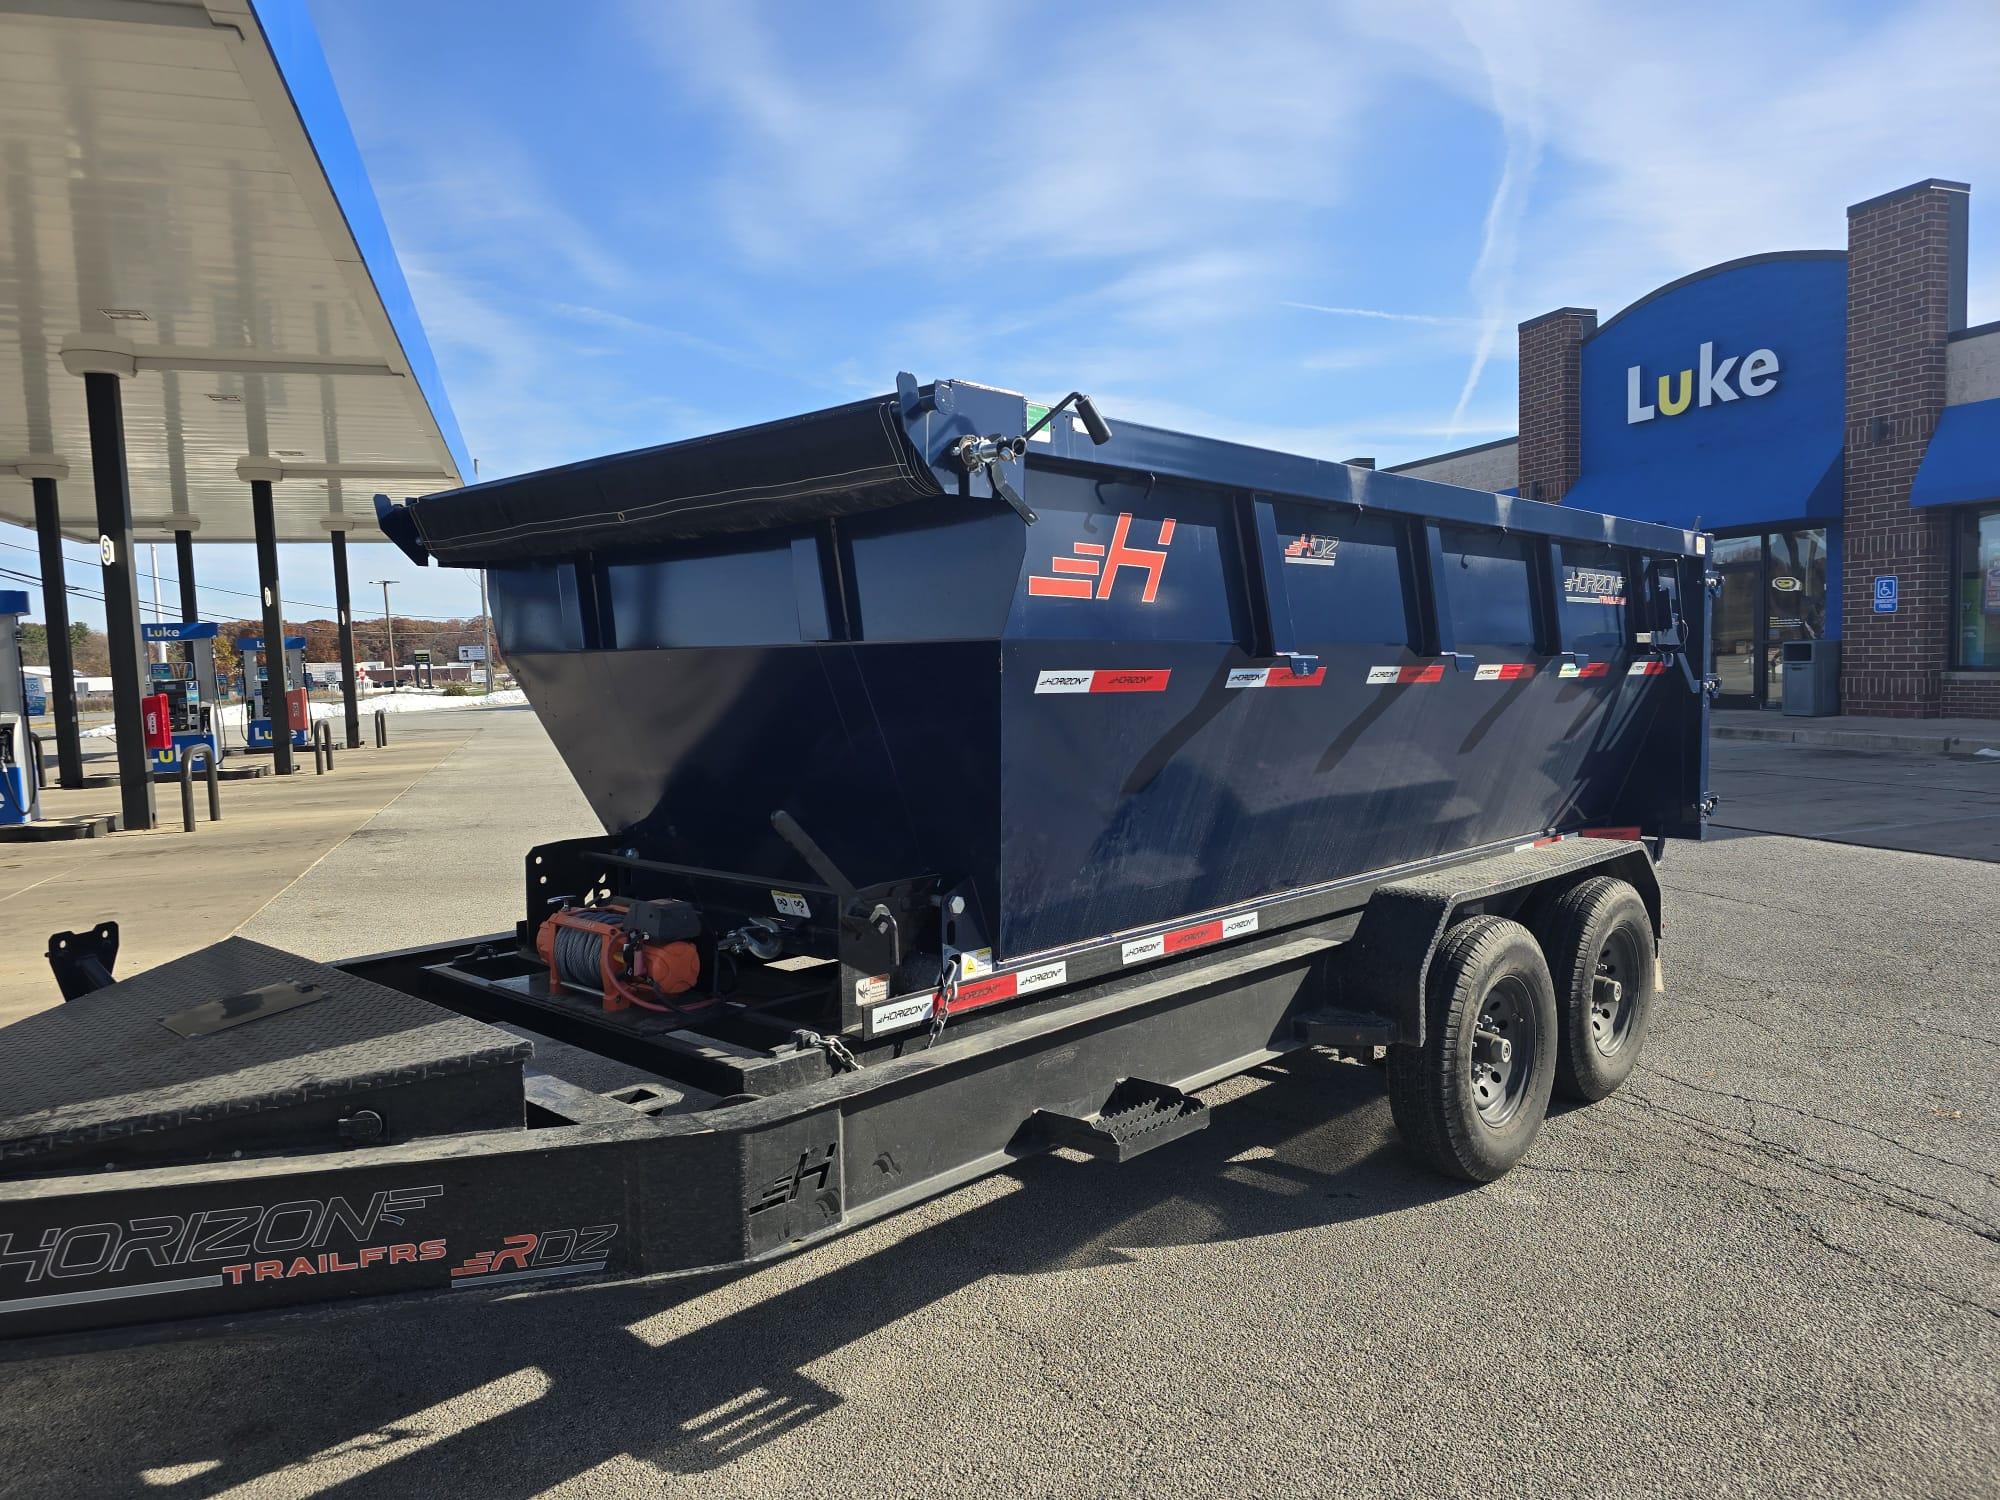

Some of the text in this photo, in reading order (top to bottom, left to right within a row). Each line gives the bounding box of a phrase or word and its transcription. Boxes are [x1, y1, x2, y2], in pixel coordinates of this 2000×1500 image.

[1628, 342, 1779, 424] Luke
[147, 627, 180, 637] Luke
[1040, 677, 1089, 686] HORIZON
[152, 743, 206, 763] uke
[1225, 917, 1256, 932] HORIZON
[1124, 941, 1162, 957] HORIZON
[1020, 968, 1063, 986] HORIZON
[876, 1002, 930, 1024] HORIZON
[0, 1191, 389, 1283] HORIZON
[490, 1223, 619, 1272] RDZ
